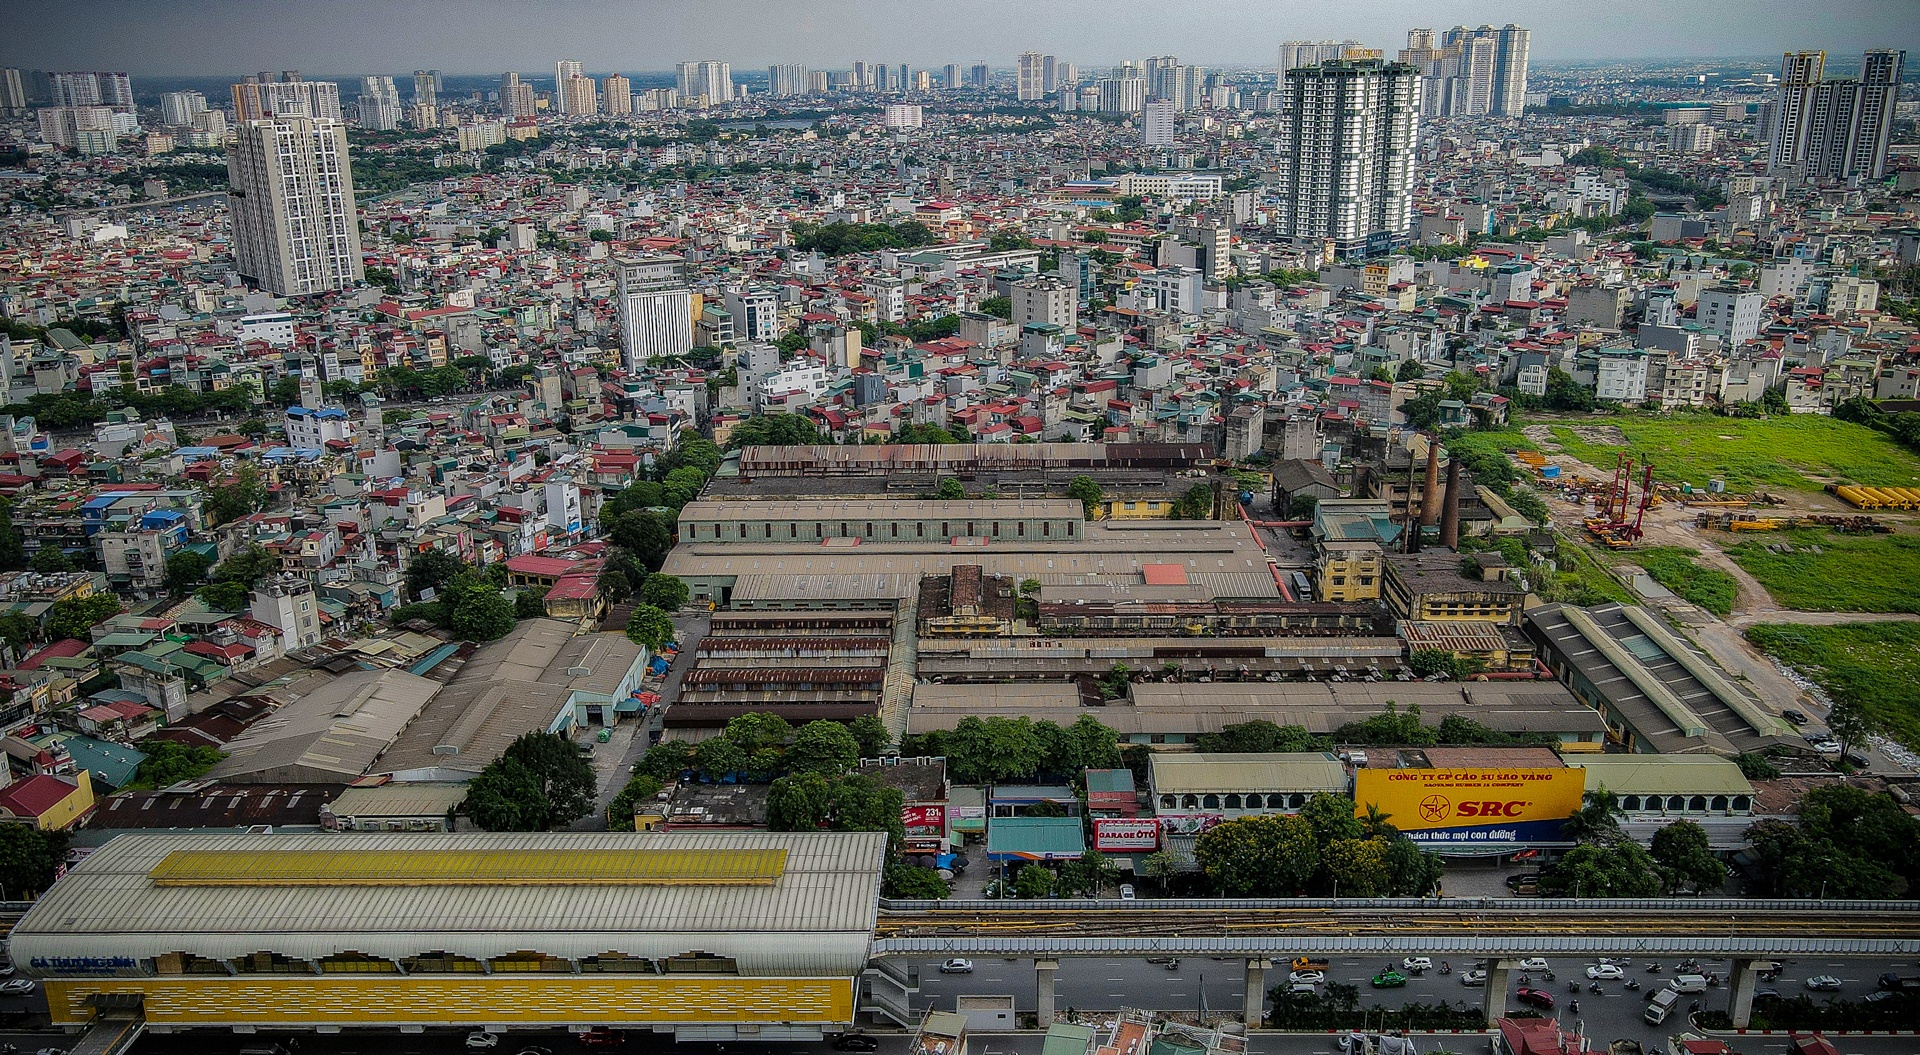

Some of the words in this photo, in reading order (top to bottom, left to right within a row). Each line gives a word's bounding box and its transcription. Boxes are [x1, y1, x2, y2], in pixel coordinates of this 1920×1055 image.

[1388, 772, 1417, 781] CÔNG
[1456, 801, 1526, 817] SRC
[1137, 829, 1155, 838] ÔTÔ
[1431, 831, 1450, 839] thức
[1453, 831, 1468, 841] mọi
[1471, 831, 1487, 839] con
[1489, 830, 1516, 841] đường
[30, 957, 48, 967] GA
